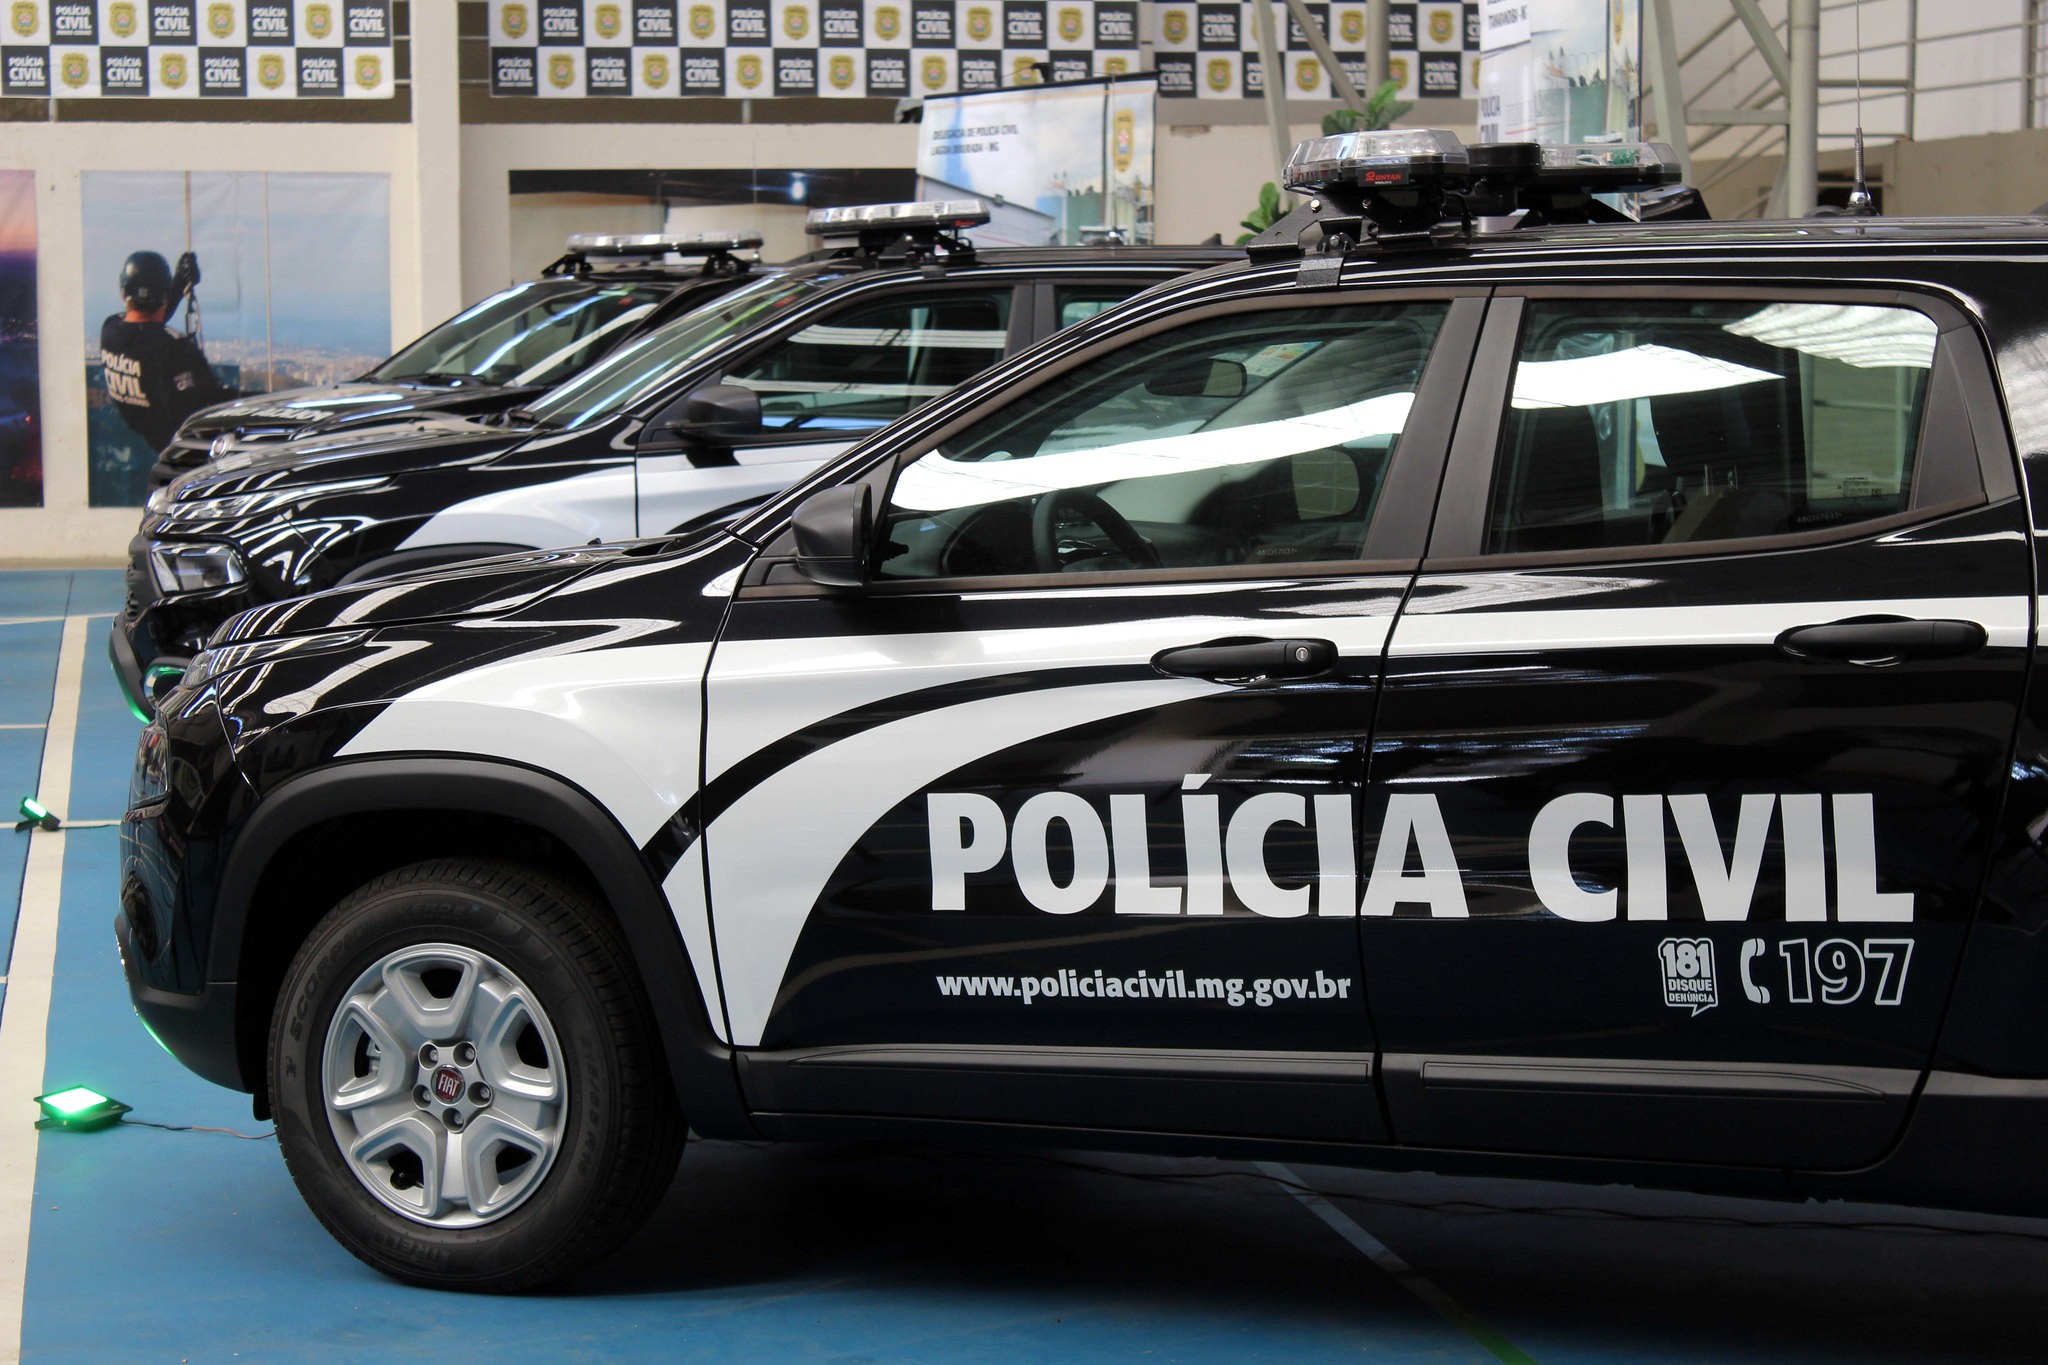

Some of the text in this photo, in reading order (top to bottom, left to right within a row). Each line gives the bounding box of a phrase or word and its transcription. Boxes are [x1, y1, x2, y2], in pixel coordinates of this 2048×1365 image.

[56, 5, 91, 16] POLÍCIA
[154, 5, 189, 16] POLÍCIA
[252, 6, 287, 17] POLÍCIA
[349, 6, 384, 18] POLÍCIA
[56, 16, 92, 30] CIVIL
[154, 17, 190, 30] CIVIL
[252, 18, 288, 31] CIVIL
[349, 18, 385, 31] CIVIL
[543, 18, 578, 31] CIVIL
[637, 18, 673, 31] CIVIL
[731, 19, 767, 32] CIVIL
[824, 20, 859, 33] CIVIL
[916, 20, 952, 34] CIVIL
[1008, 21, 1043, 34] CIVIL
[1099, 22, 1134, 35] CIVIL
[1202, 24, 1237, 37] CIVIL
[9, 56, 45, 67] POLÍCIA
[107, 56, 142, 67] POLÍCIA
[204, 56, 239, 68] POLÍCIA
[302, 57, 337, 68] POLÍCIA
[9, 68, 46, 81] CIVIL
[107, 68, 143, 81] CIVIL
[204, 68, 240, 81] CIVIL
[302, 69, 338, 82] CIVIL
[498, 68, 533, 81] CIVIL
[591, 68, 626, 81] CIVIL
[685, 69, 721, 81] CIVIL
[780, 69, 814, 82] CIVIL
[871, 70, 906, 82] CIVIL
[962, 70, 997, 83] CIVIL
[1424, 72, 1458, 85] CIVIL
[1365, 171, 1402, 182] RONTAN
[101, 349, 140, 378] POLÍCIA
[104, 368, 146, 399] CIVIL
[927, 774, 1914, 922] POLÍCIA CIVIL
[1663, 943, 1711, 978] 181
[290, 907, 388, 1041] SCORPION
[1779, 938, 1915, 1006] 197
[936, 969, 1351, 1007] www.policiacivil.mg.gov.br
[1668, 979, 1713, 992] DISQUE
[1669, 992, 1715, 1003] DENÚNCIA
[438, 1073, 460, 1096] FIAT
